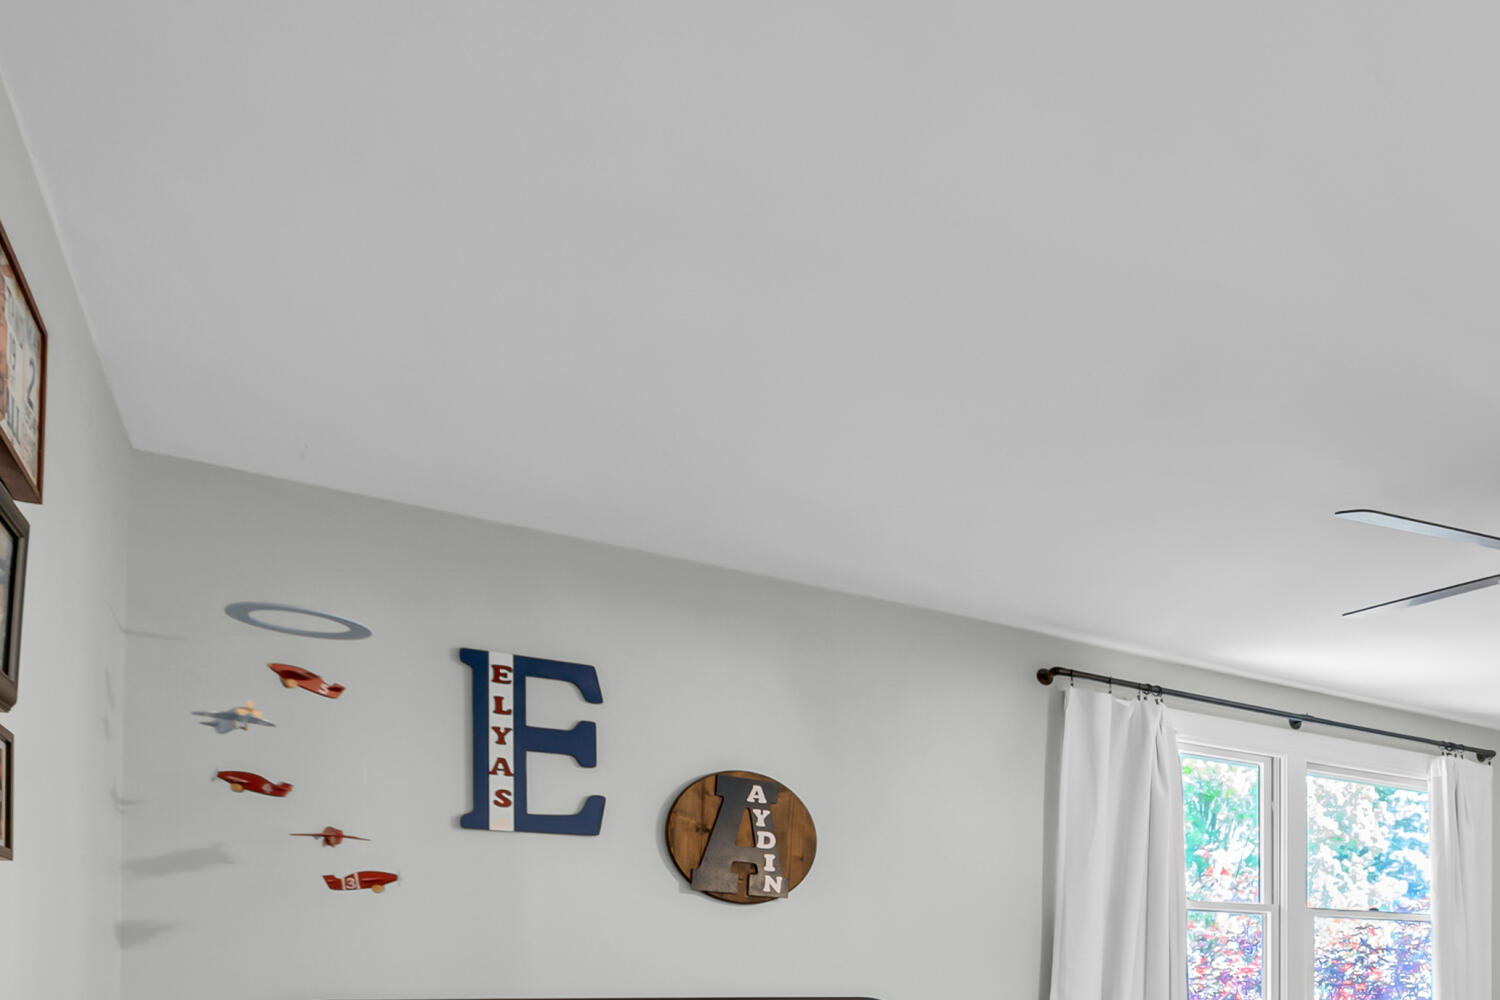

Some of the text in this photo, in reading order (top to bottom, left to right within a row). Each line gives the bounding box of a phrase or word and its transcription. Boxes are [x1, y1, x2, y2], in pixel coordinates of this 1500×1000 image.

[460, 648, 605, 836] E
[489, 665, 514, 808] ELYAS
[746, 784, 784, 893] AYDIN
